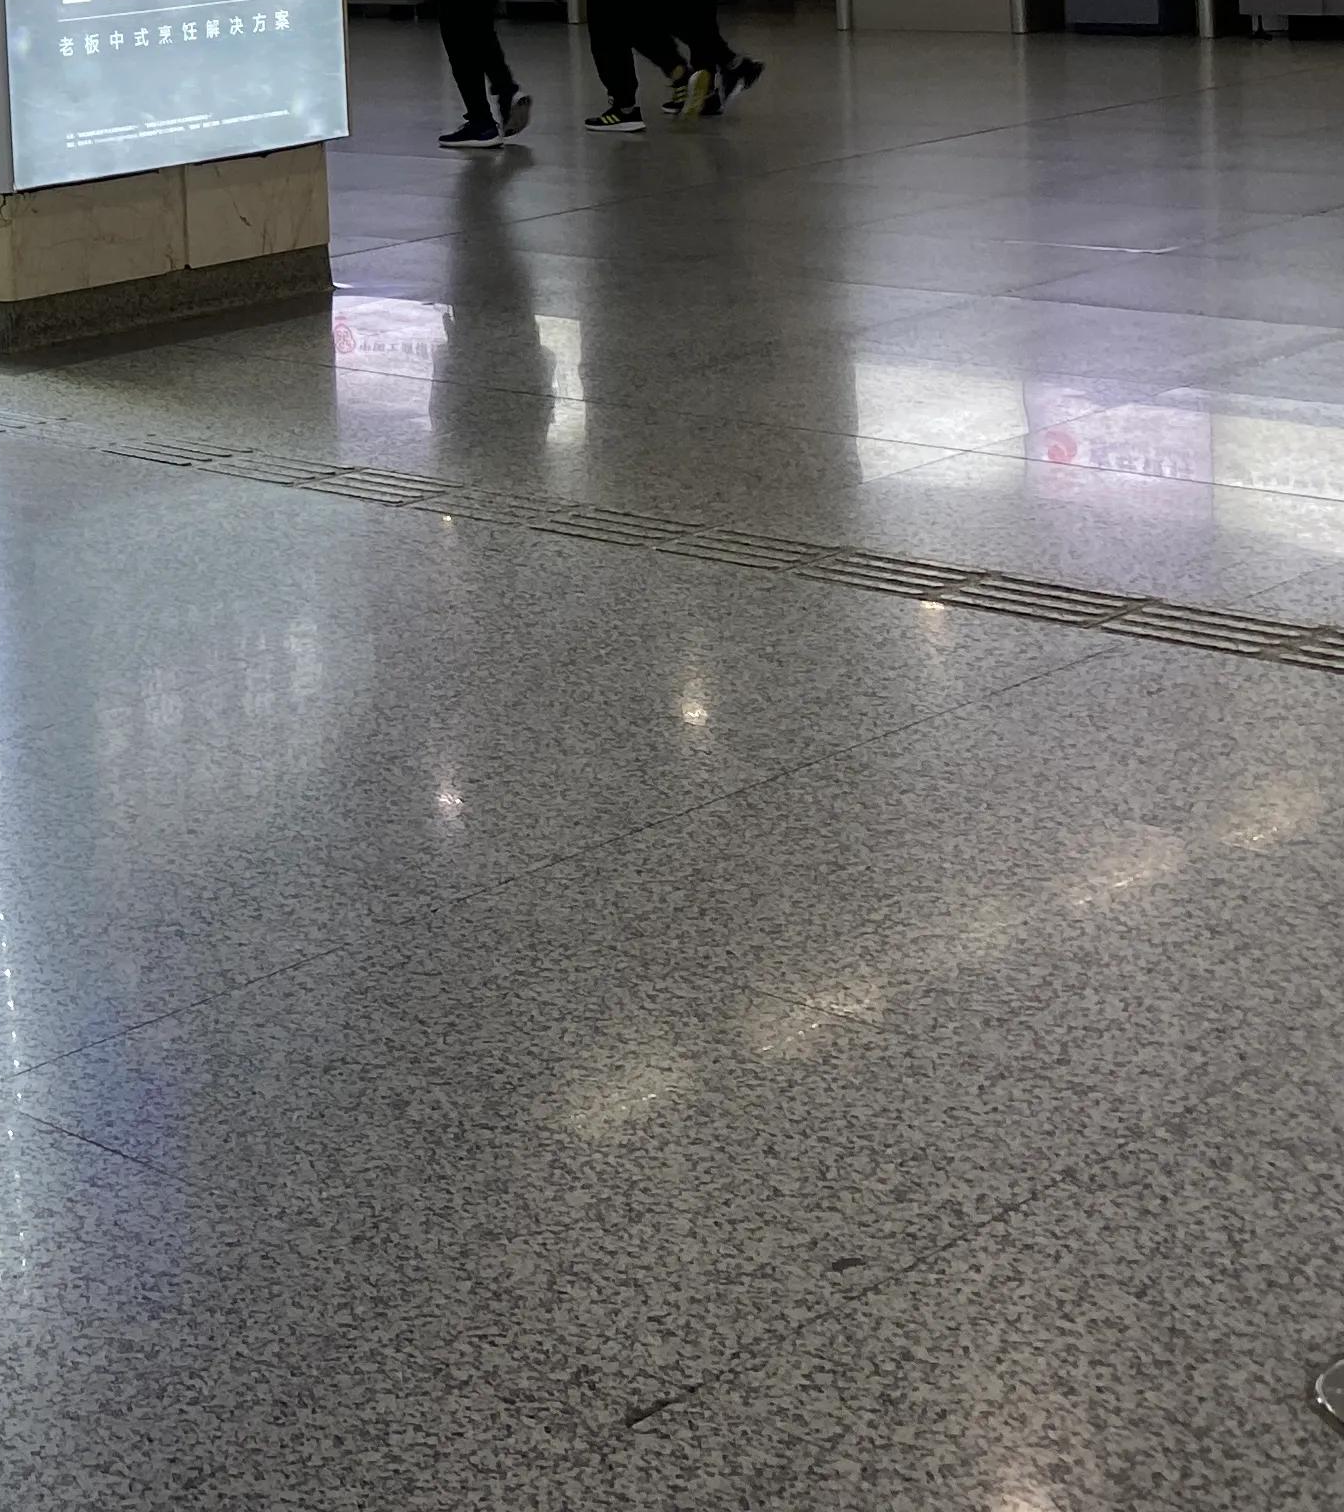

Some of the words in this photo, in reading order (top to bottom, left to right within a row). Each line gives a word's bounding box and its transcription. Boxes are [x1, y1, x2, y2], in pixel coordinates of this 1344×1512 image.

[58, 9, 291, 58] 老板中式烹饪解决方案
